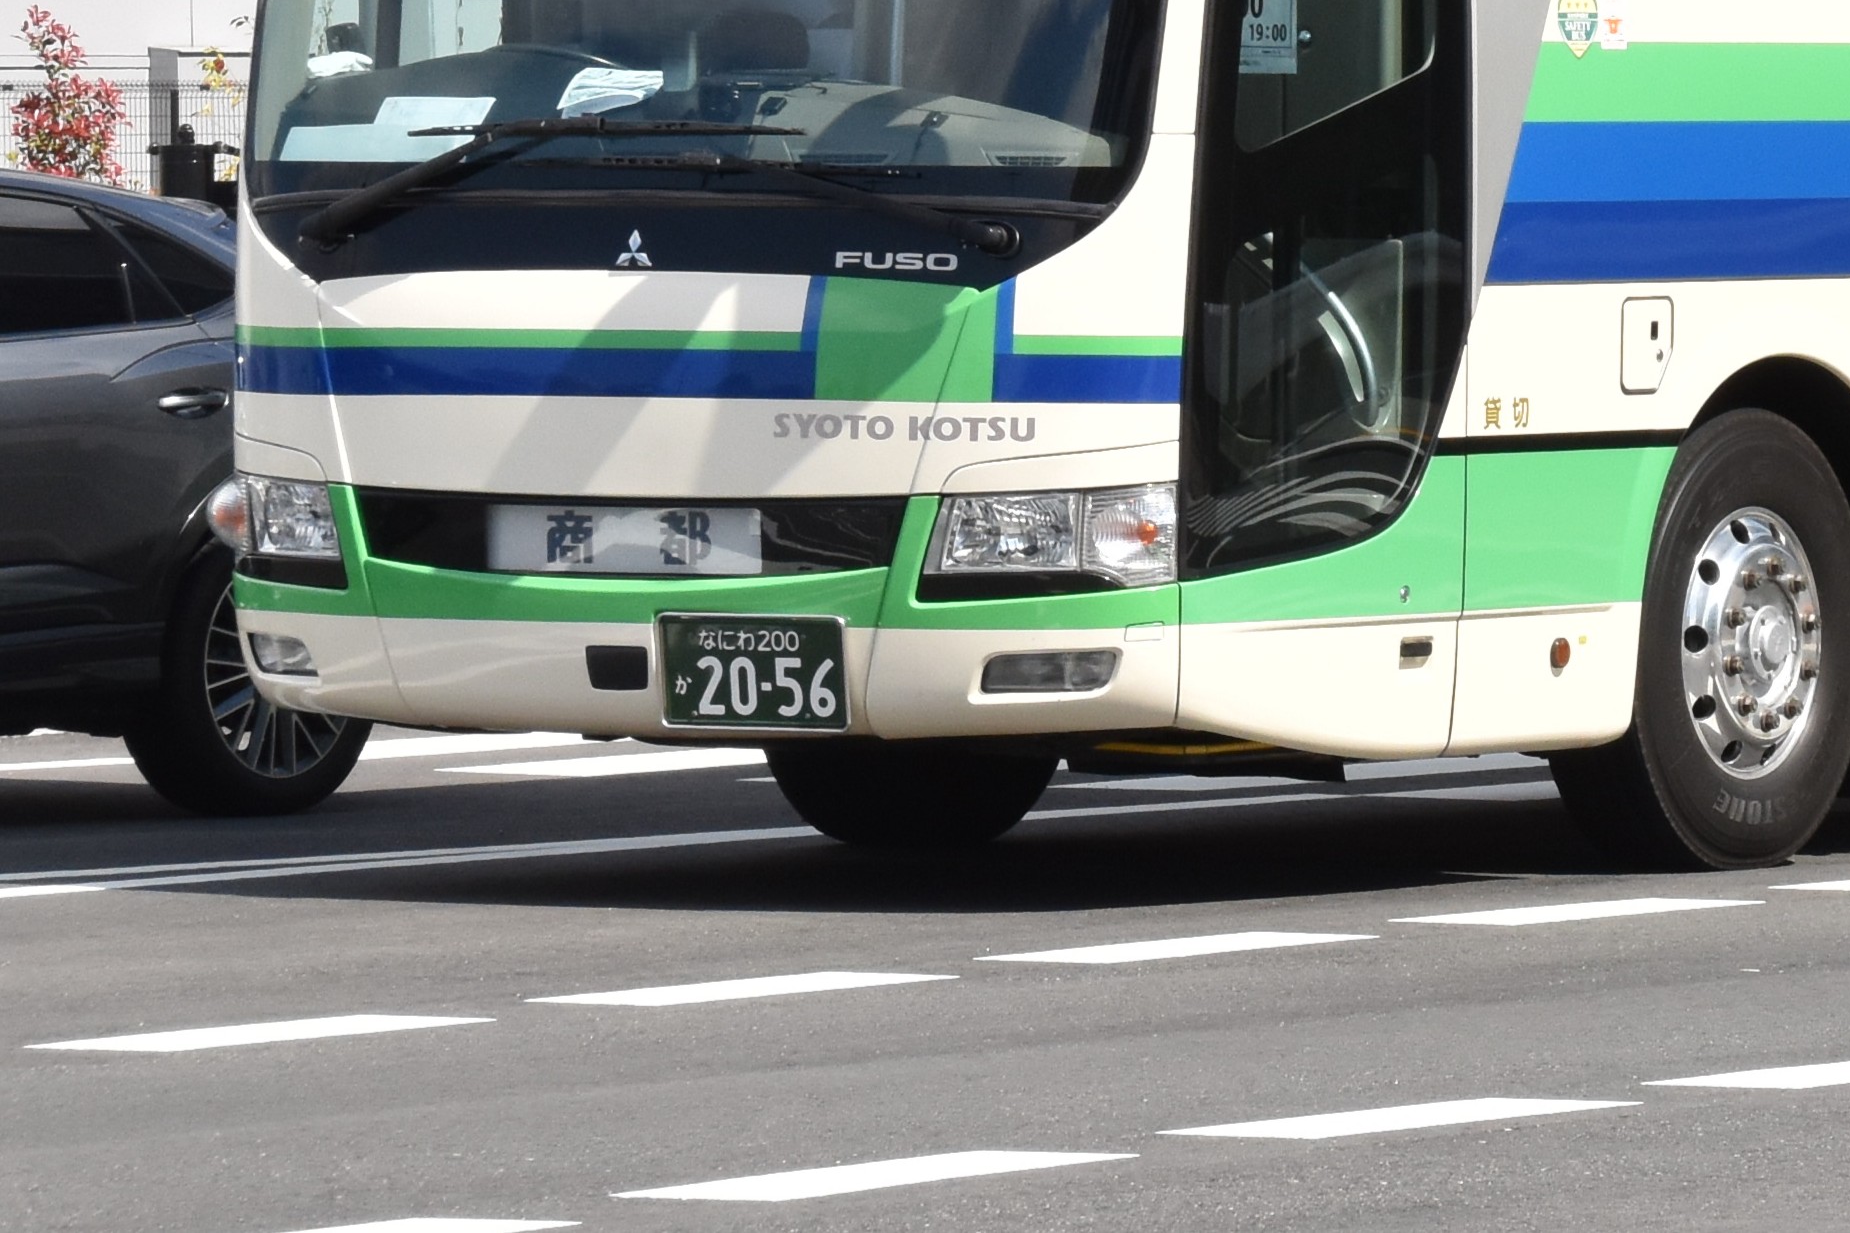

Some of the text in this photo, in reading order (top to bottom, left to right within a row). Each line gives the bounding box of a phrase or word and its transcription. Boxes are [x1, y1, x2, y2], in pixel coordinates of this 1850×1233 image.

[1249, 23, 1287, 42] 19:00
[835, 251, 959, 271] FUSO
[773, 413, 1036, 442] SYOTO KOTSU
[1483, 397, 1530, 430] 貸切
[546, 510, 711, 566] 商都
[675, 655, 838, 718] か 20-56
